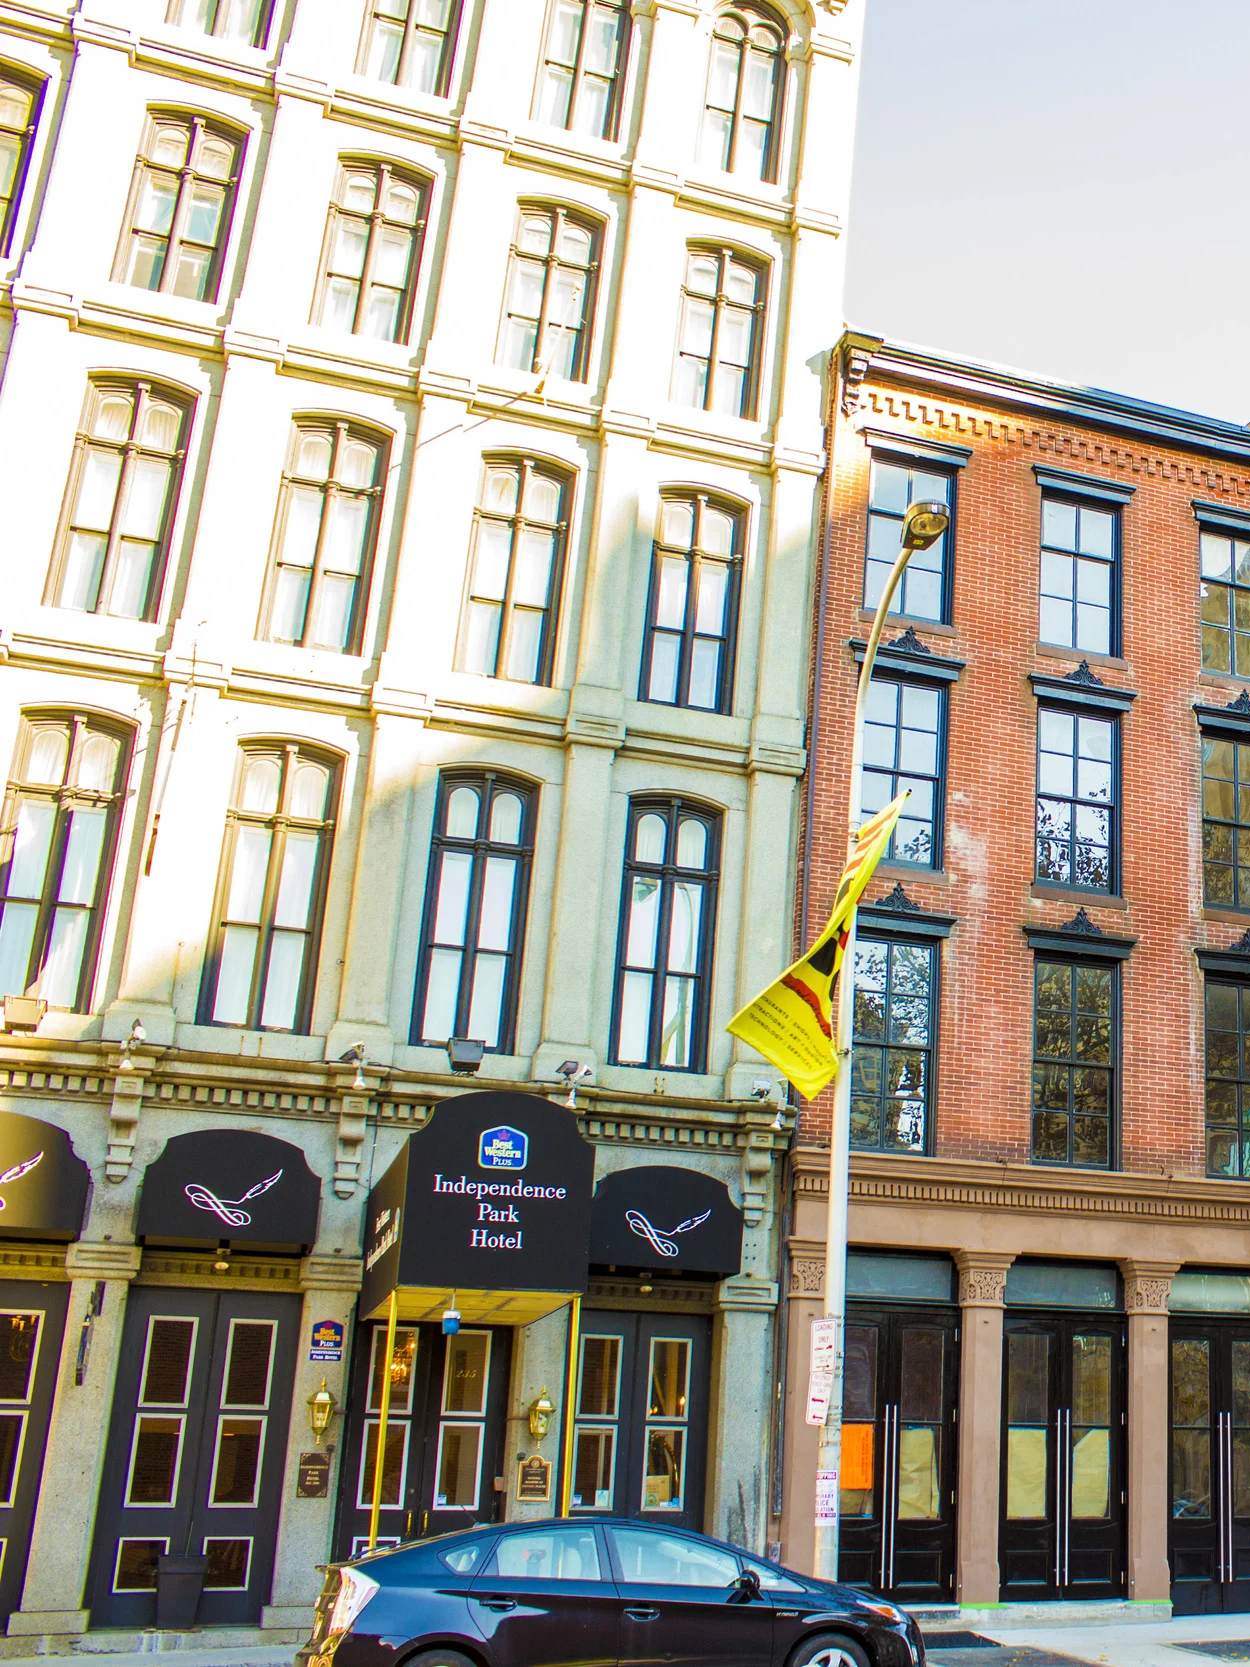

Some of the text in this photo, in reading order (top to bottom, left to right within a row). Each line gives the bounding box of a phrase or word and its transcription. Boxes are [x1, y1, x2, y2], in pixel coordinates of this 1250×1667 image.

[484, 1146, 521, 1158] Western
[492, 1139, 513, 1150] Best
[433, 1174, 566, 1199] Independence
[477, 1202, 519, 1222] Park
[470, 1228, 523, 1249] Hotel
[815, 1323, 833, 1331] LOADING
